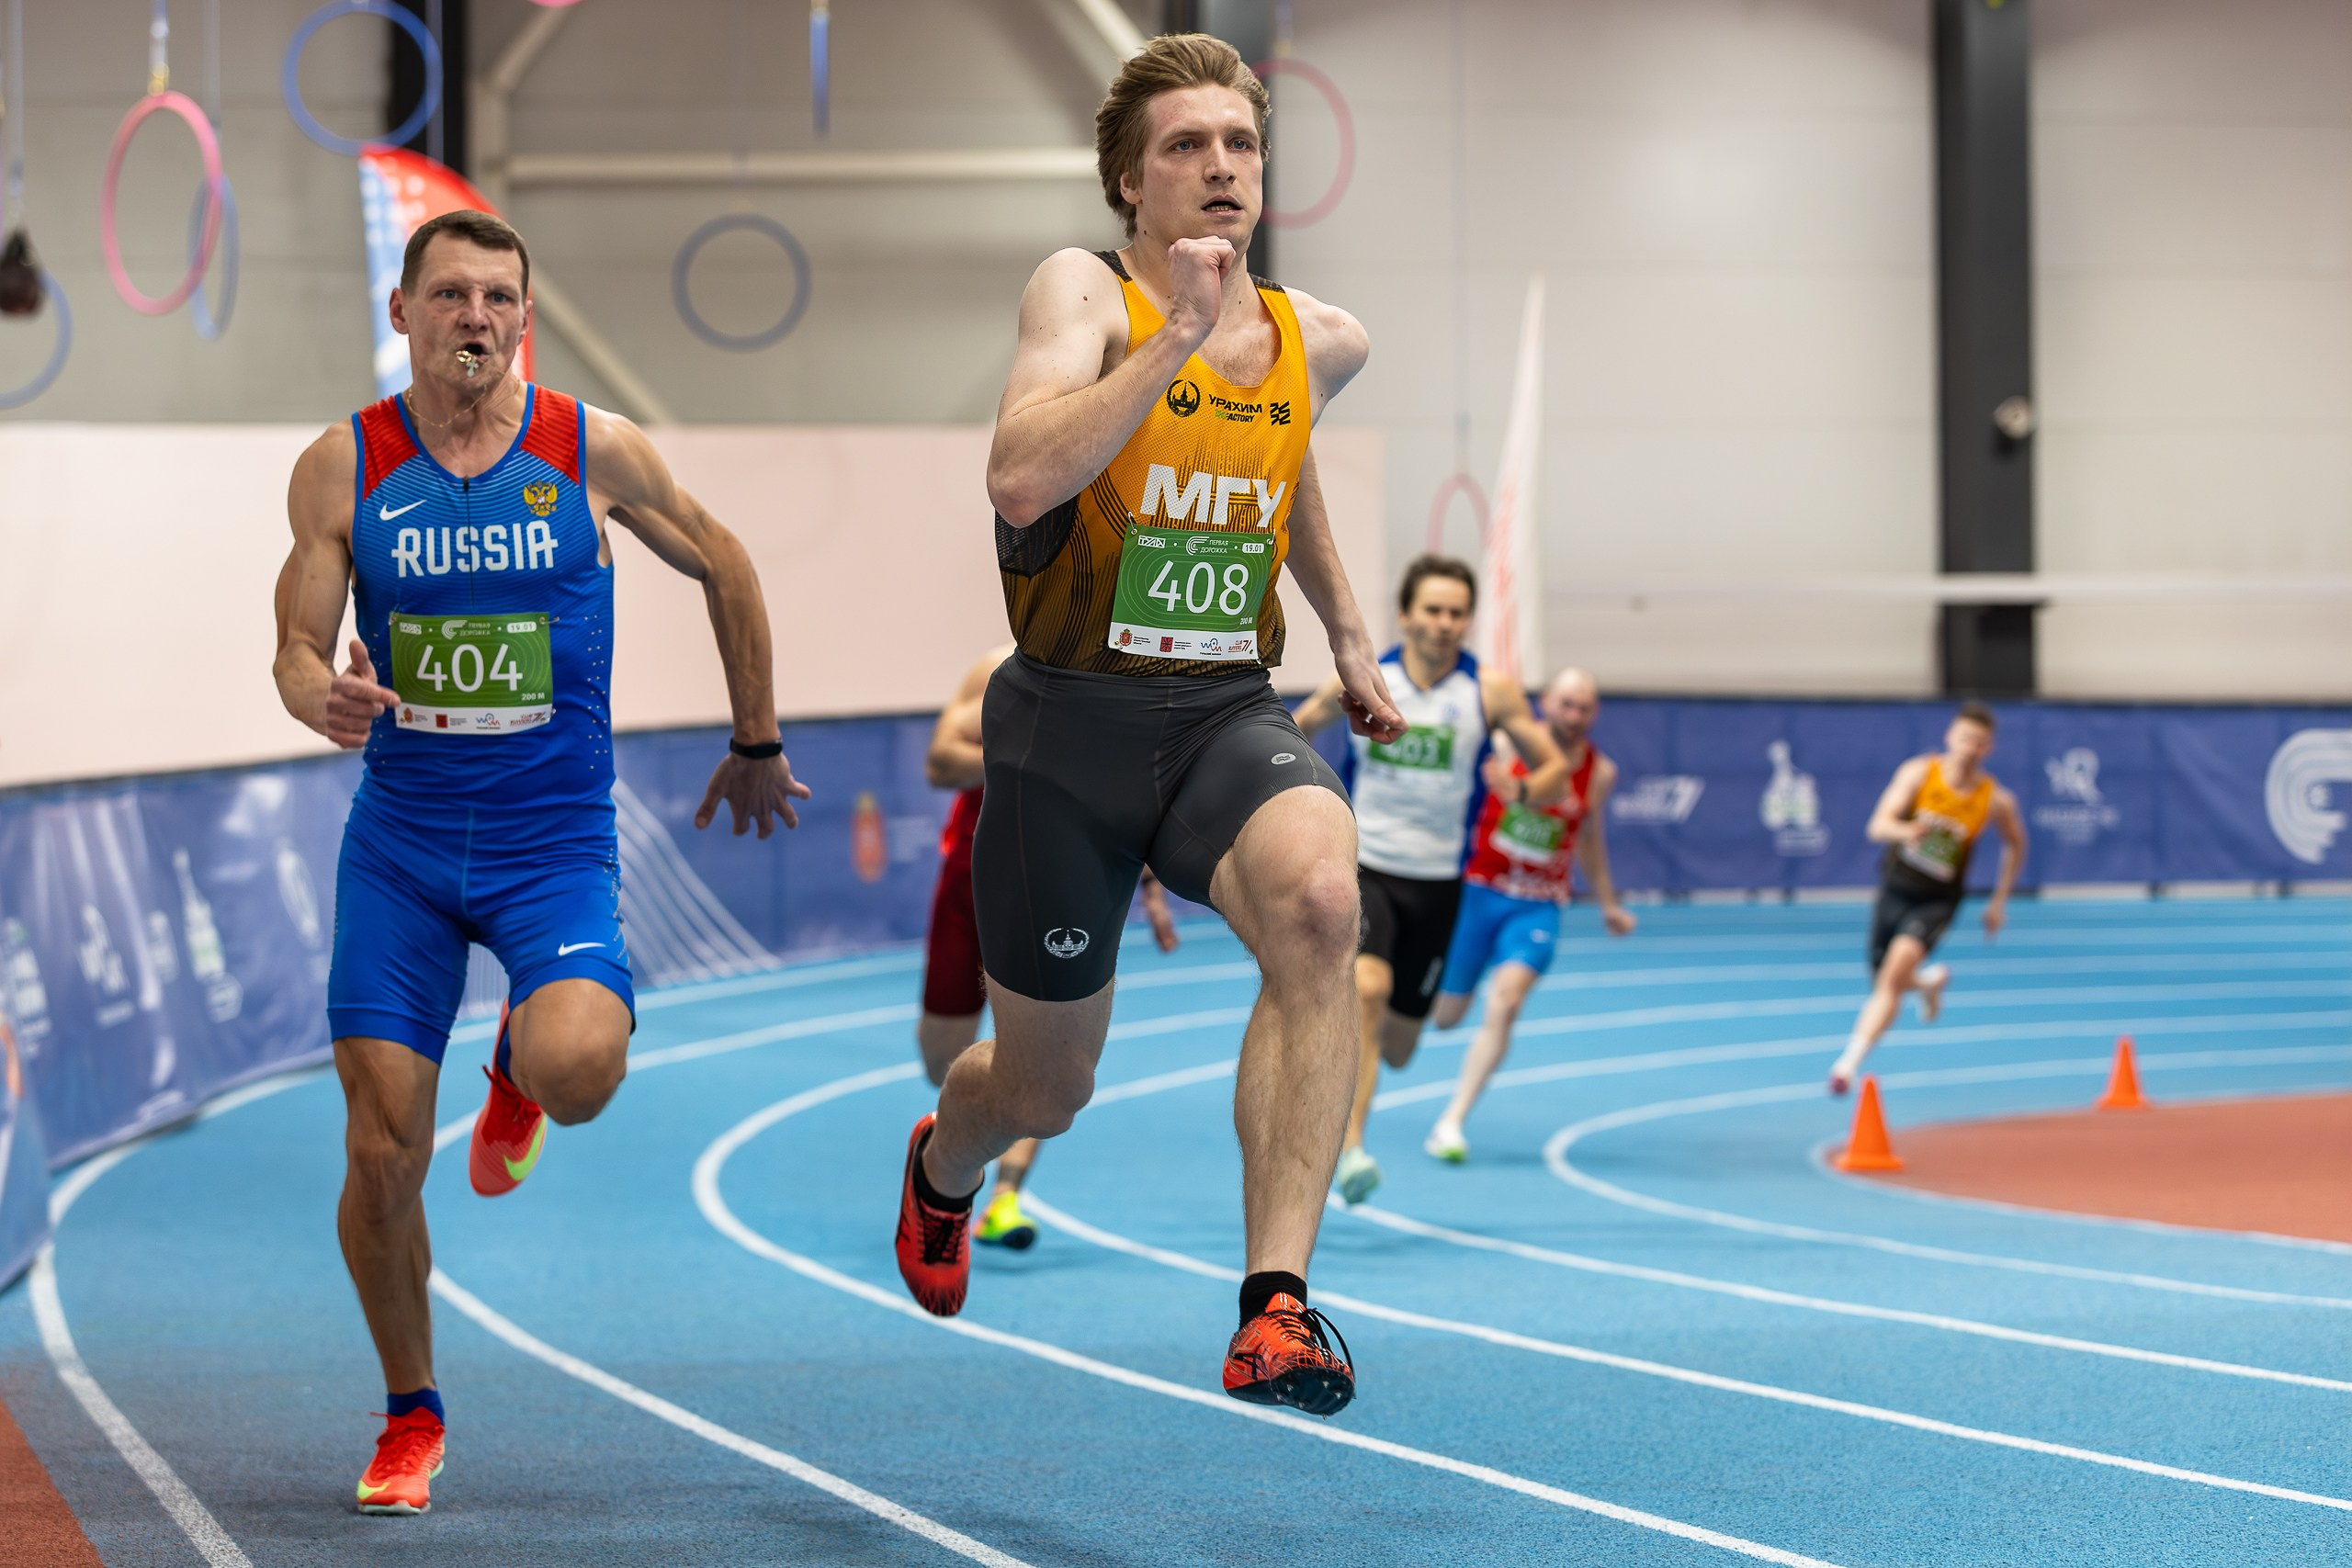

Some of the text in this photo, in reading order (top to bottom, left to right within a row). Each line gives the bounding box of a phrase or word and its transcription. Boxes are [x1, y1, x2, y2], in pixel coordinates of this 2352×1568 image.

[1208, 393, 1263, 413] УРАХИМ
[1140, 463, 1286, 527] МГУ
[390, 520, 559, 578] RUSSIA
[1245, 544, 1261, 552] 19.01
[1148, 559, 1249, 615] 408
[416, 643, 524, 693] 404
